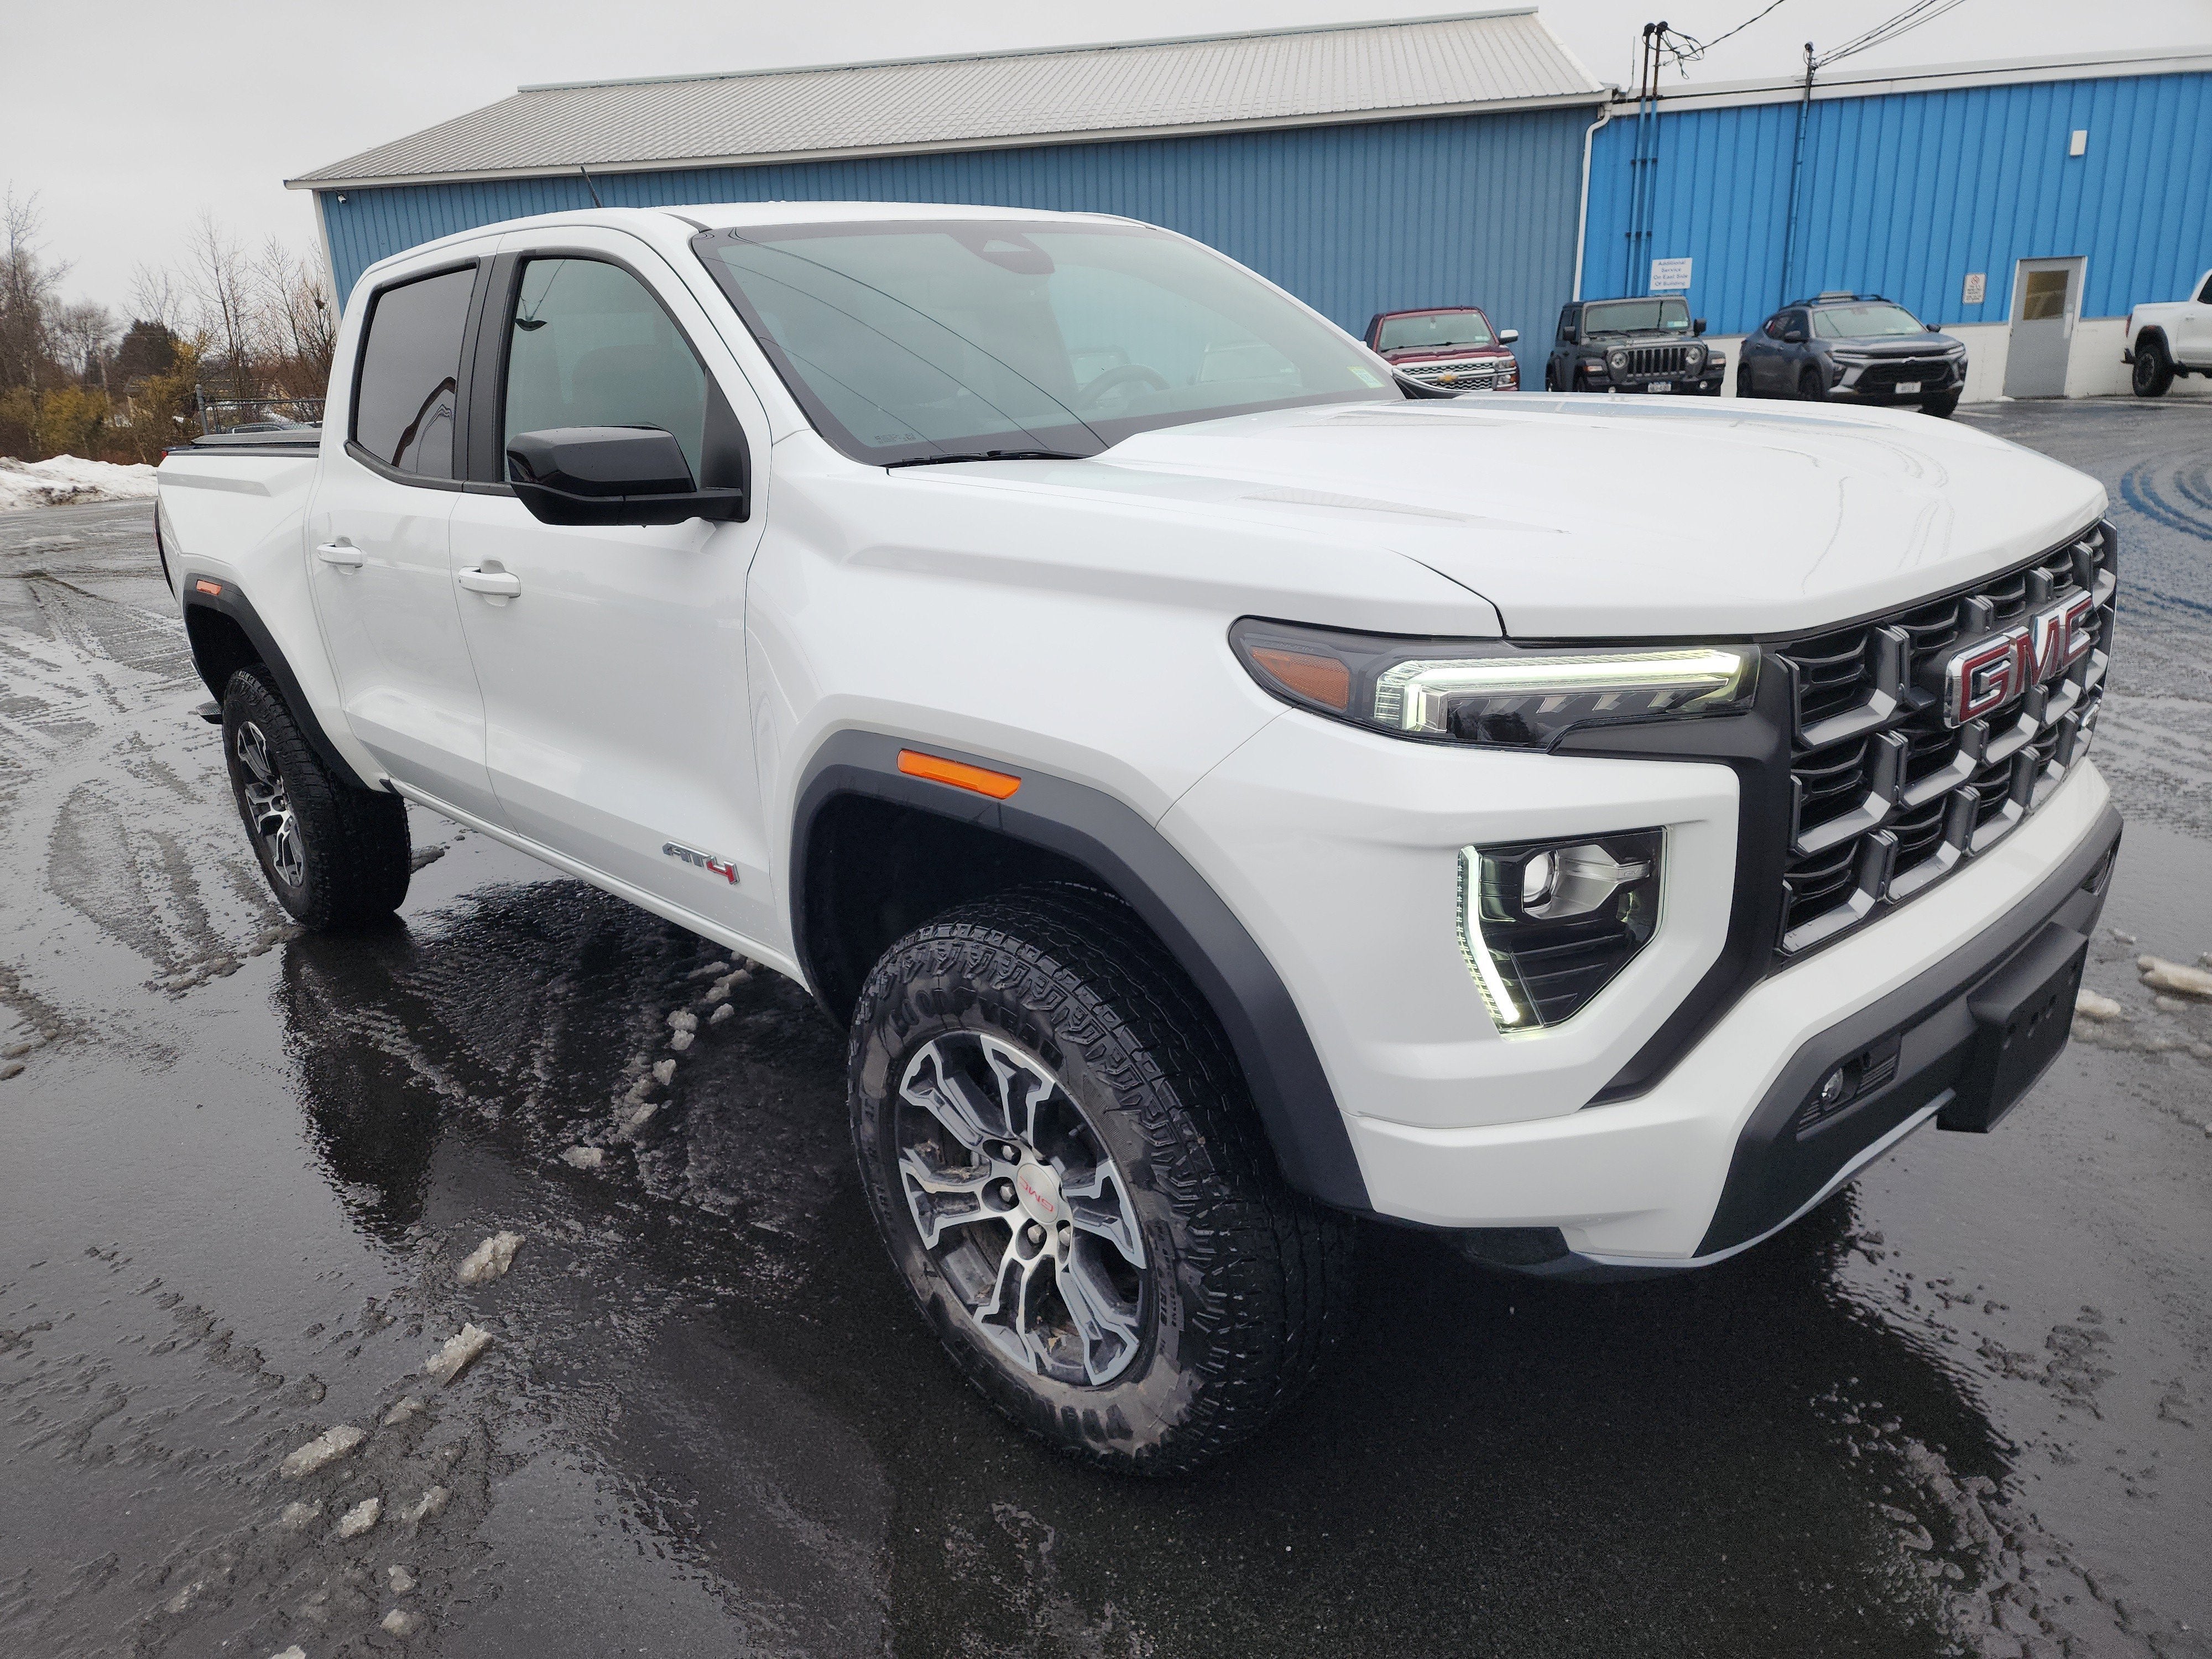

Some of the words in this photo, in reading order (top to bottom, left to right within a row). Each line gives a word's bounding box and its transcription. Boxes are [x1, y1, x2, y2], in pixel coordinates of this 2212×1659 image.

[1944, 590, 2093, 729] GMC
[662, 841, 740, 885] AT4
[1019, 1176, 1055, 1212] GMC
